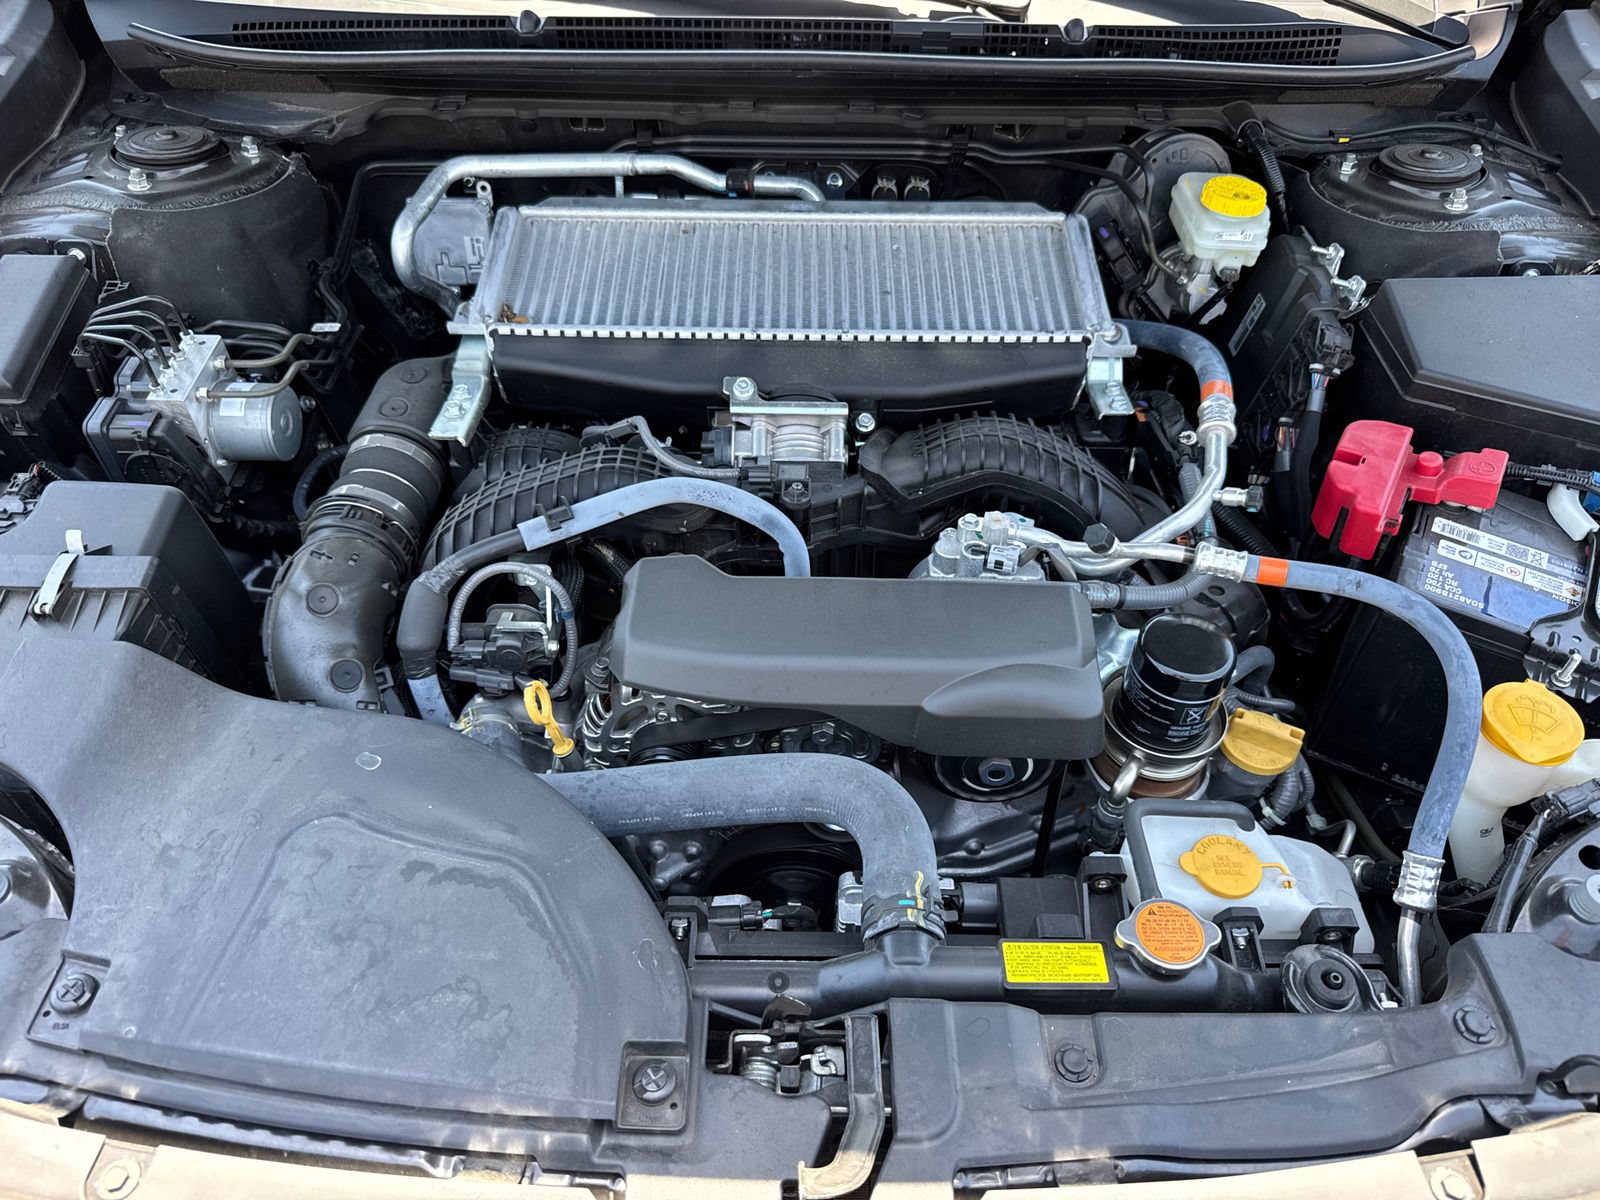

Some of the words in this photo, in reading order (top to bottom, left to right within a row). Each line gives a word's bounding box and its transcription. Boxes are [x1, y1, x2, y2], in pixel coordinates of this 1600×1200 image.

[1431, 560, 1448, 570] EFB
[1427, 572, 1443, 581] 120
[1426, 578, 1442, 588] 750
[1444, 584, 1462, 594] CCA
[1196, 837, 1251, 855] COOLANT
